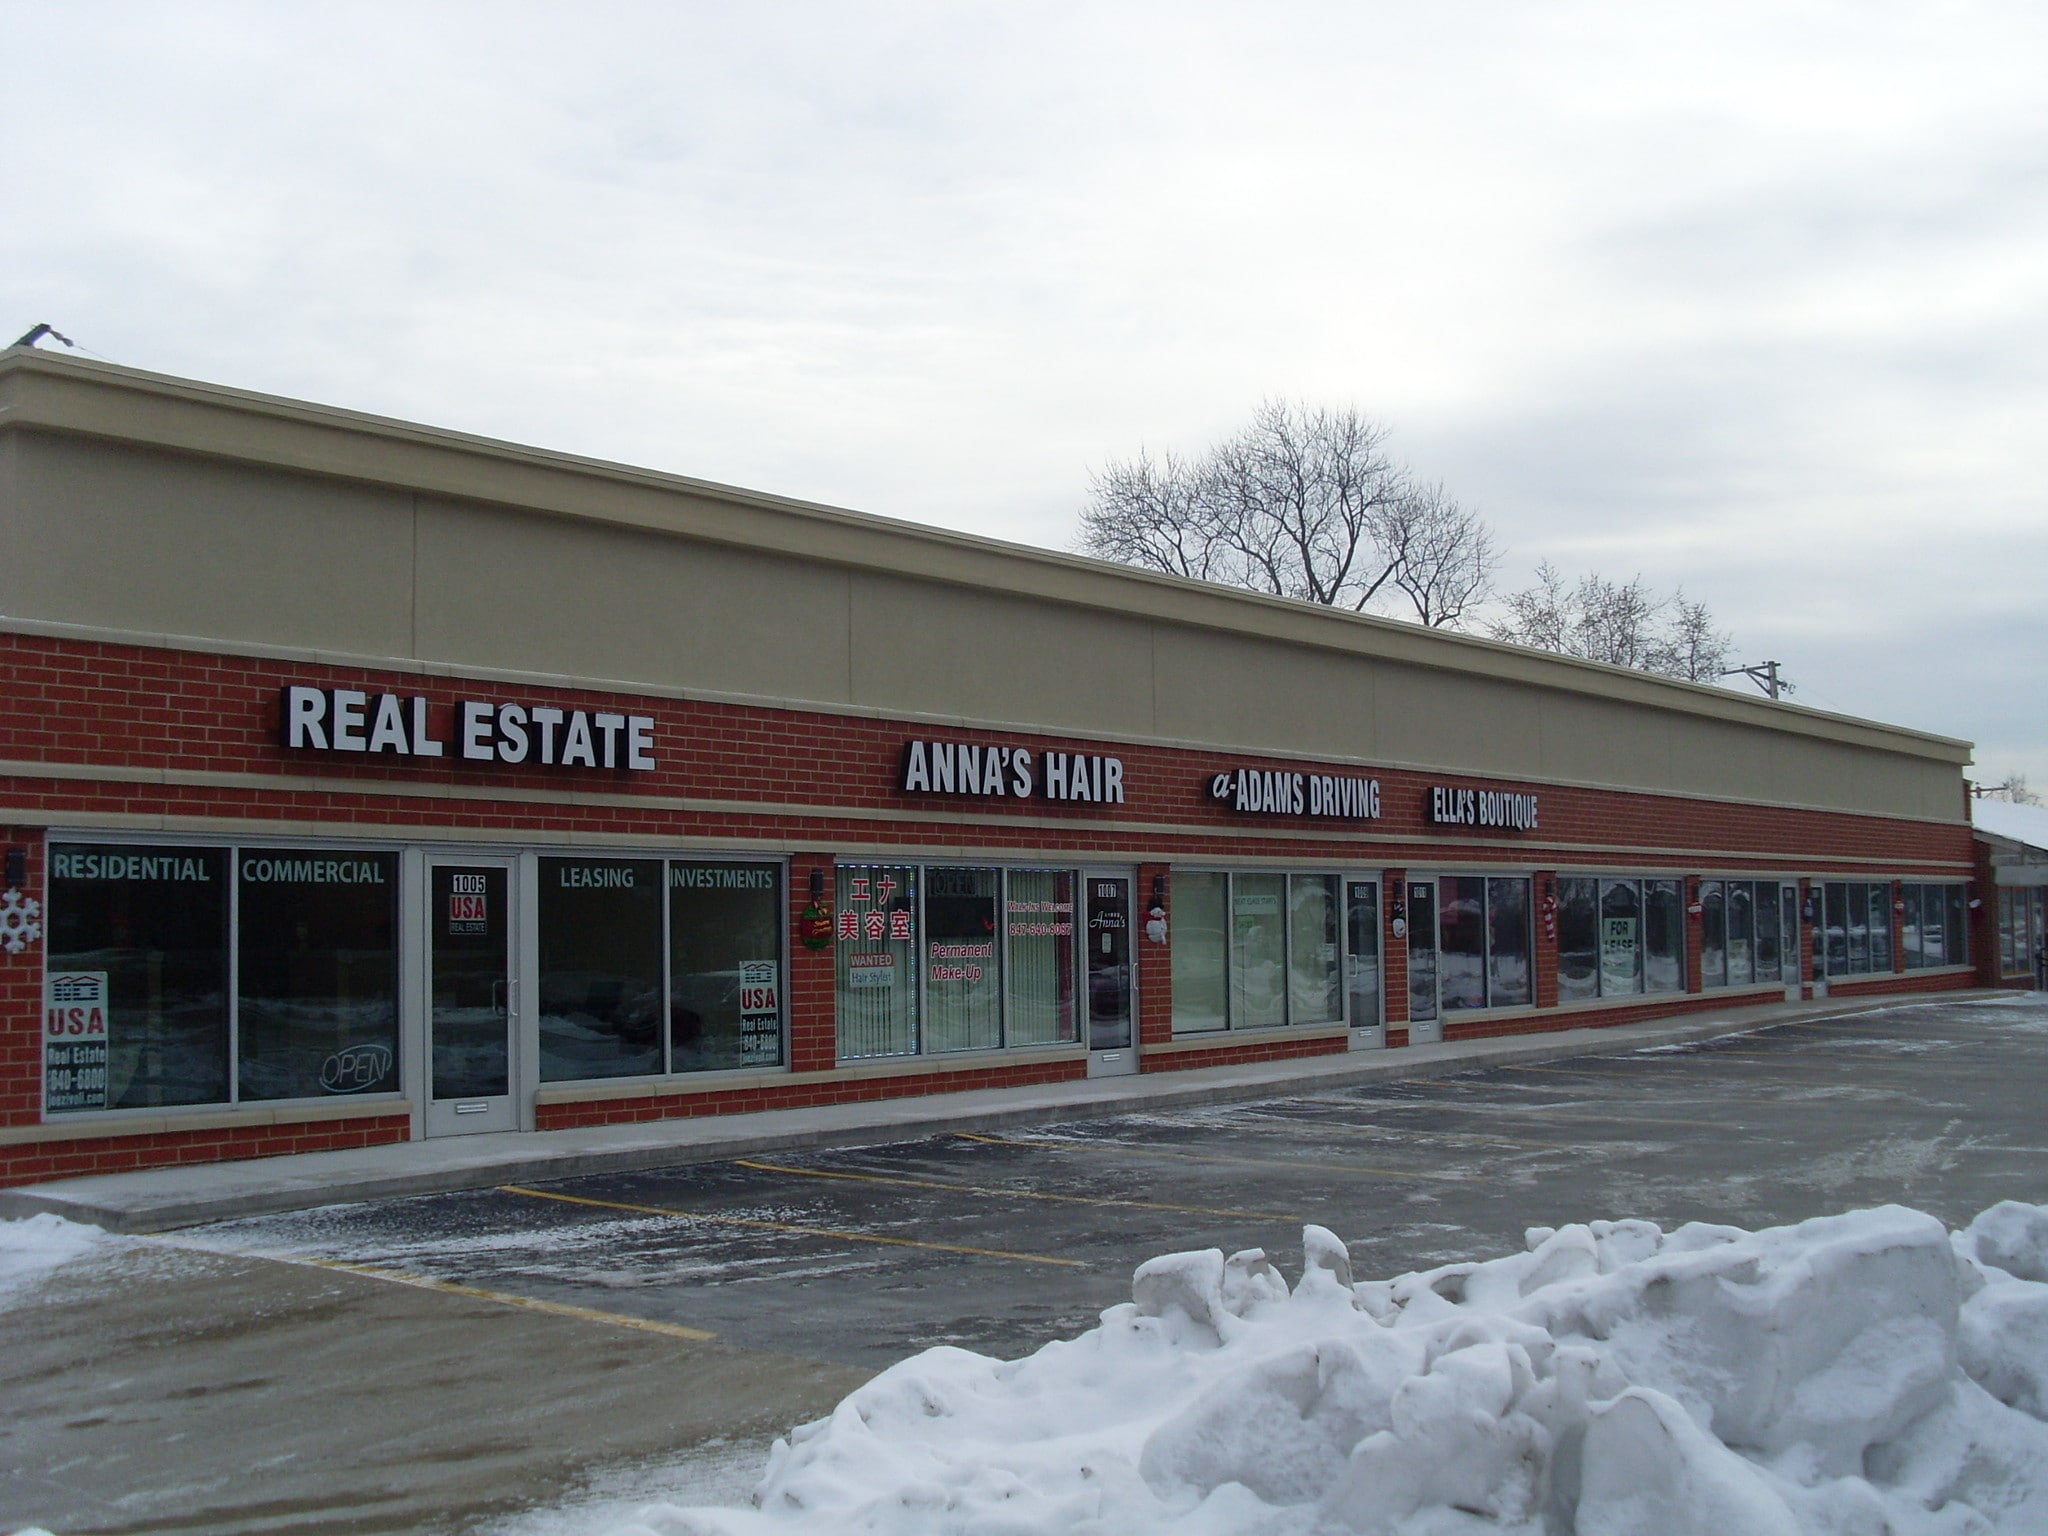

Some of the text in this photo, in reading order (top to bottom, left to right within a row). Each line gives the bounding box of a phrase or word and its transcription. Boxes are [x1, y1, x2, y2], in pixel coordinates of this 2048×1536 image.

[289, 686, 655, 771] REAL ESTATE
[905, 740, 1125, 804] ANNA'S HAIR
[1309, 774, 1380, 819] DRIVING
[1433, 786, 1538, 831] ELLA'S BOUTIQUE
[53, 854, 211, 882] RESIDENTIAL
[242, 859, 385, 884] COMMERCIAL
[560, 867, 635, 888] LEASING
[669, 868, 774, 889] INVESTMENTS
[454, 876, 485, 892] 1005
[1099, 884, 1117, 897] 1007
[451, 896, 485, 919] USA
[838, 909, 911, 941] 美容室
[1089, 911, 1126, 929] Anna's
[1611, 921, 1629, 936] FOR
[850, 954, 892, 966] WANTED
[931, 941, 993, 959] Permanent
[851, 972, 868, 981] Hair
[931, 964, 983, 984] Make-Up
[742, 987, 776, 1009] USA
[48, 1007, 105, 1036] USA
[742, 1016, 777, 1031] Real Estate
[48, 1046, 105, 1064] Real Estate
[322, 1052, 387, 1084] OPEN
